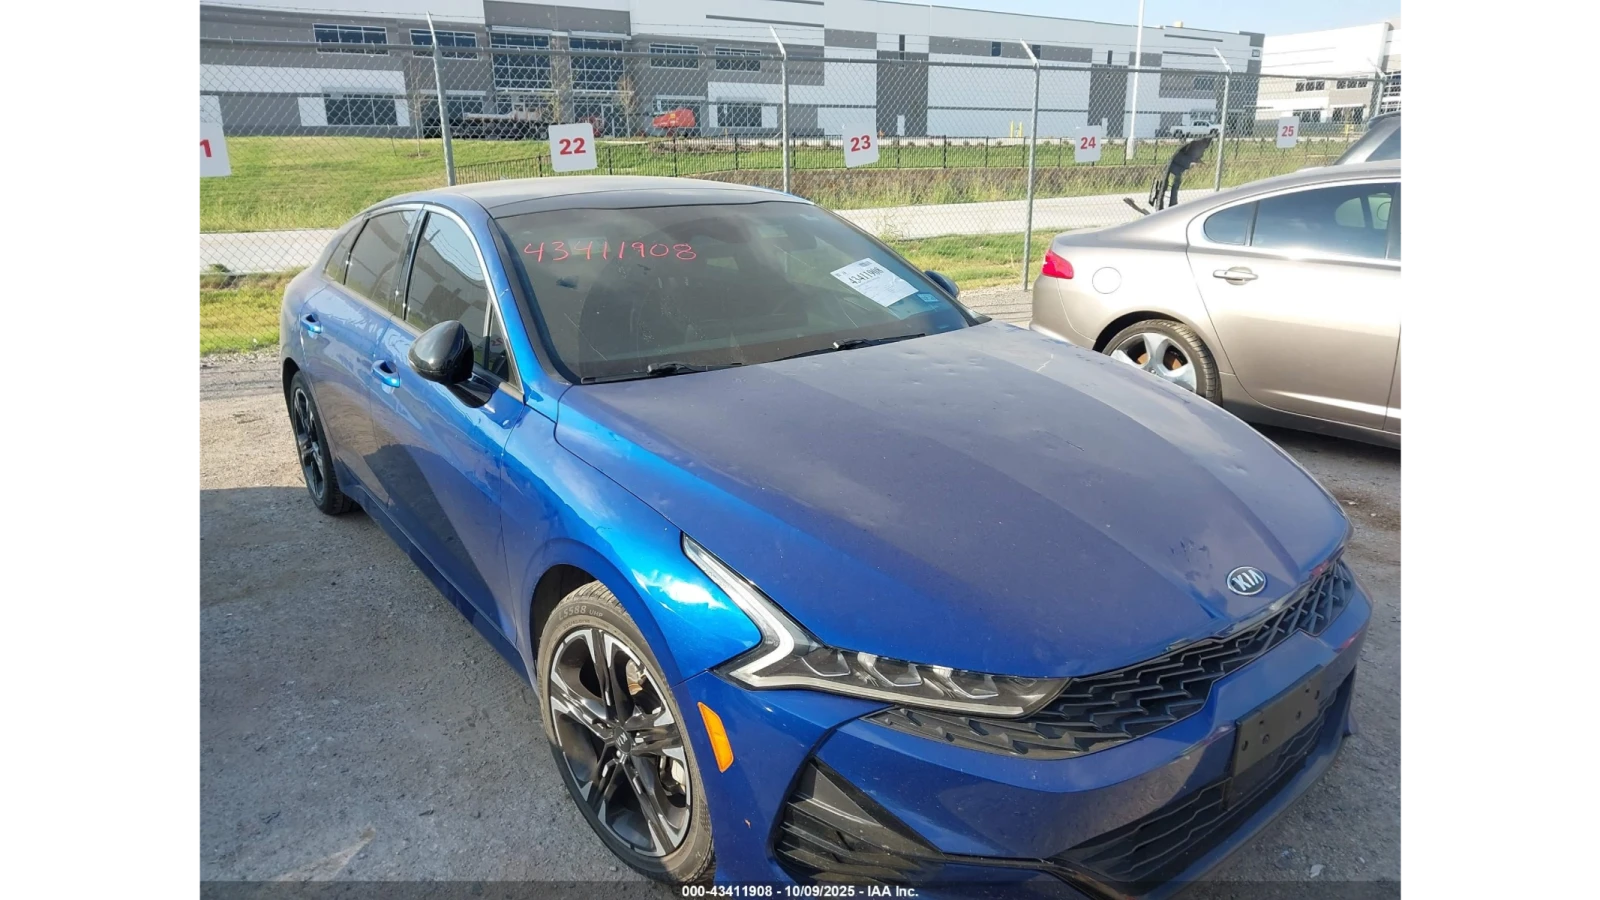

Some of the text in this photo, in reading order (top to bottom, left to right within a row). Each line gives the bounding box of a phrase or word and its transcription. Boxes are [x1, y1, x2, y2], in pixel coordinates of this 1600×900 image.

[1281, 125, 1295, 137] 25
[558, 137, 587, 155] 22
[850, 135, 872, 152] 23
[1080, 136, 1096, 150] 24
[523, 240, 698, 263] 43411908
[1231, 569, 1264, 591] KIA
[589, 609, 604, 617] UHP
[615, 732, 628, 748] KIA
